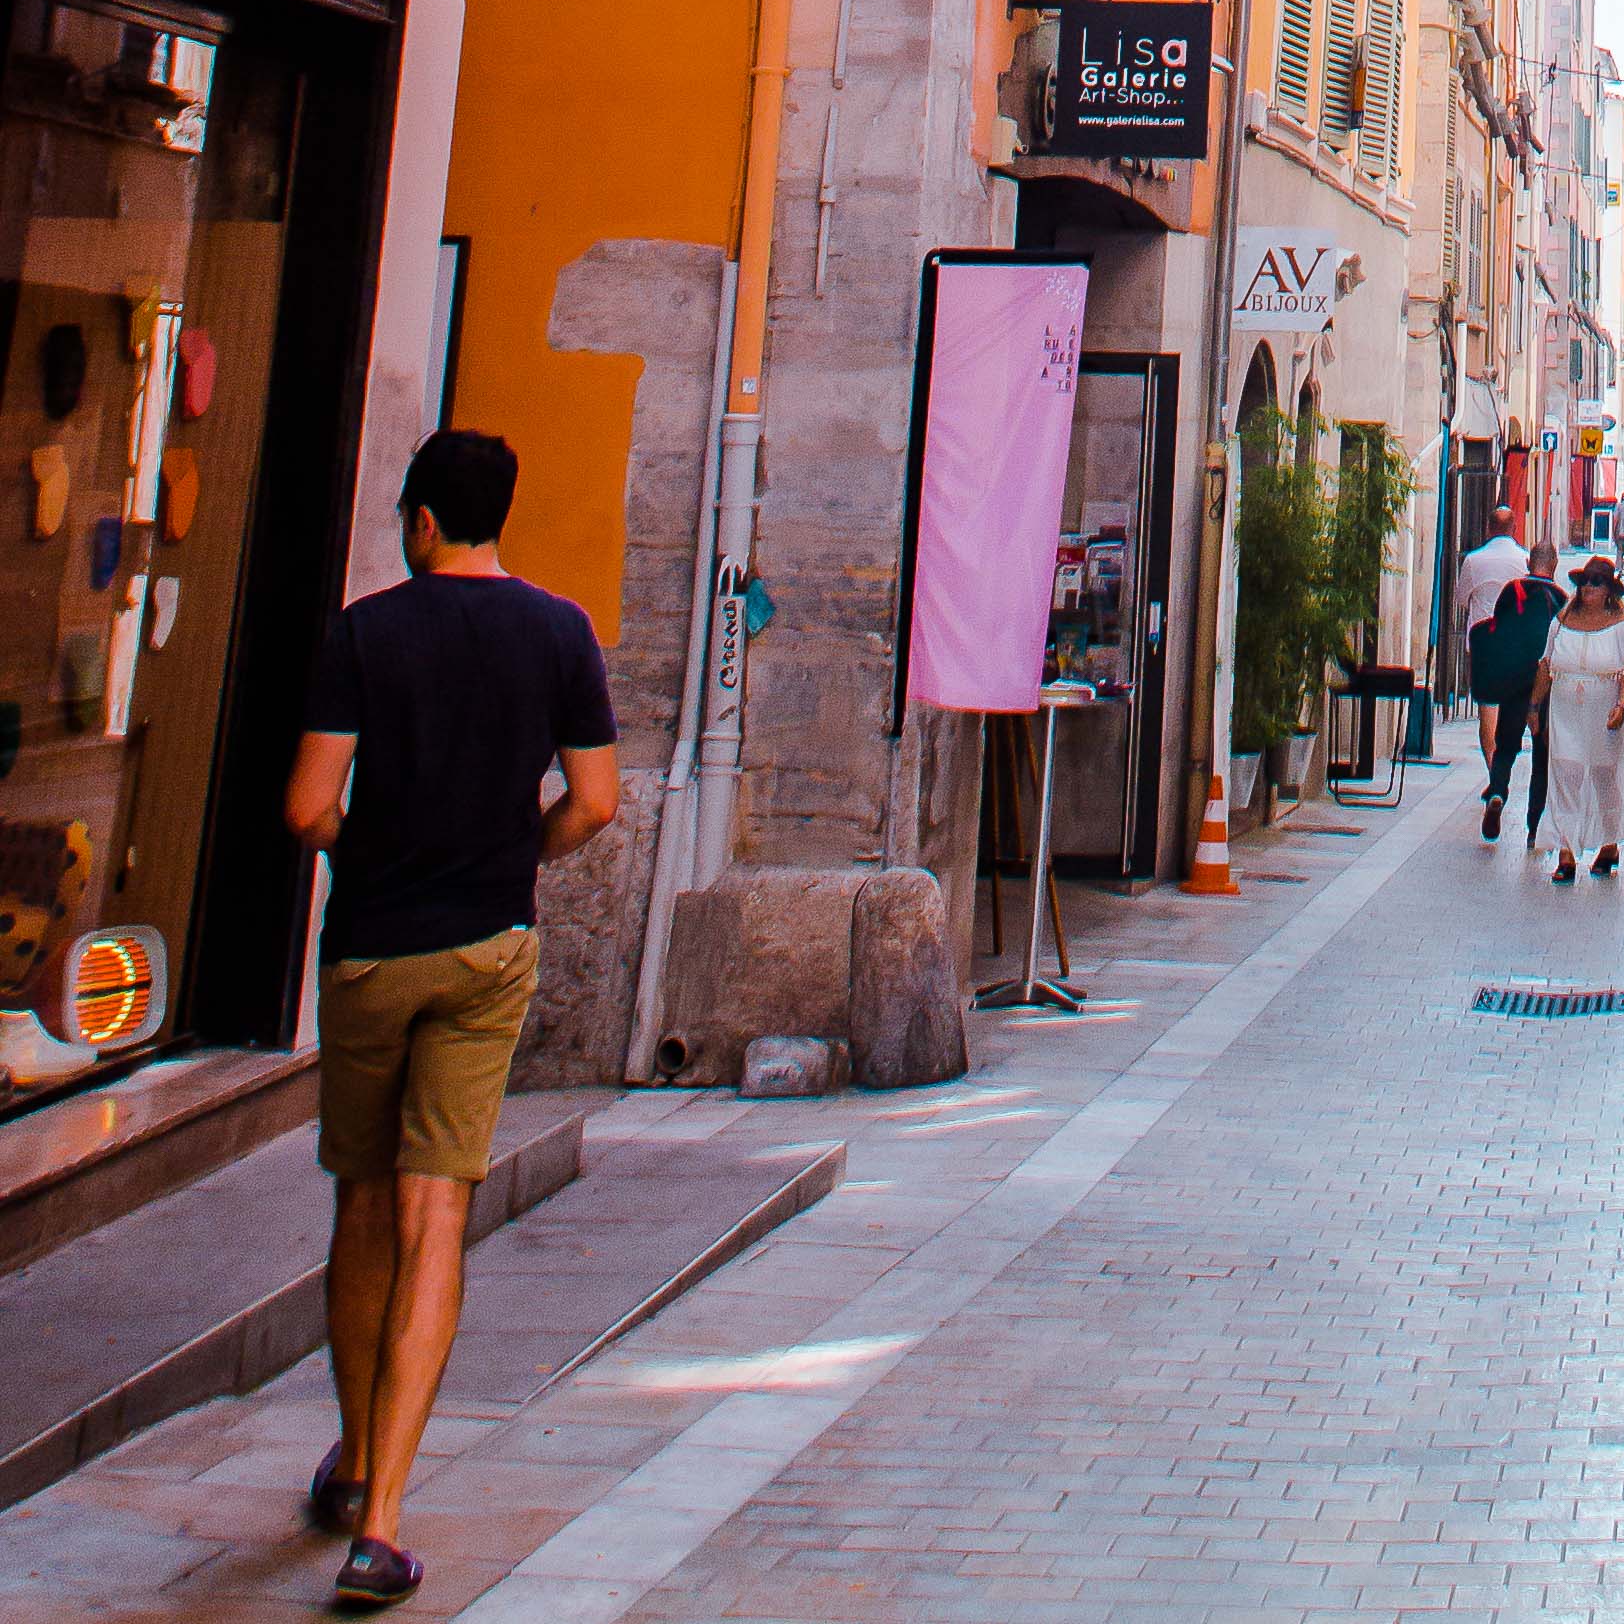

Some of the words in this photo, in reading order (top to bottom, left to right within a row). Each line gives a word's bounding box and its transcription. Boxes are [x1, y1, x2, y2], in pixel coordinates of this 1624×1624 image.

[1081, 26, 1188, 68] Lisa
[1080, 66, 1187, 89] Galerie
[1078, 114, 1185, 127] www.galerielisa.com
[1232, 246, 1331, 311] AV
[1250, 293, 1329, 313] BIJOUX
